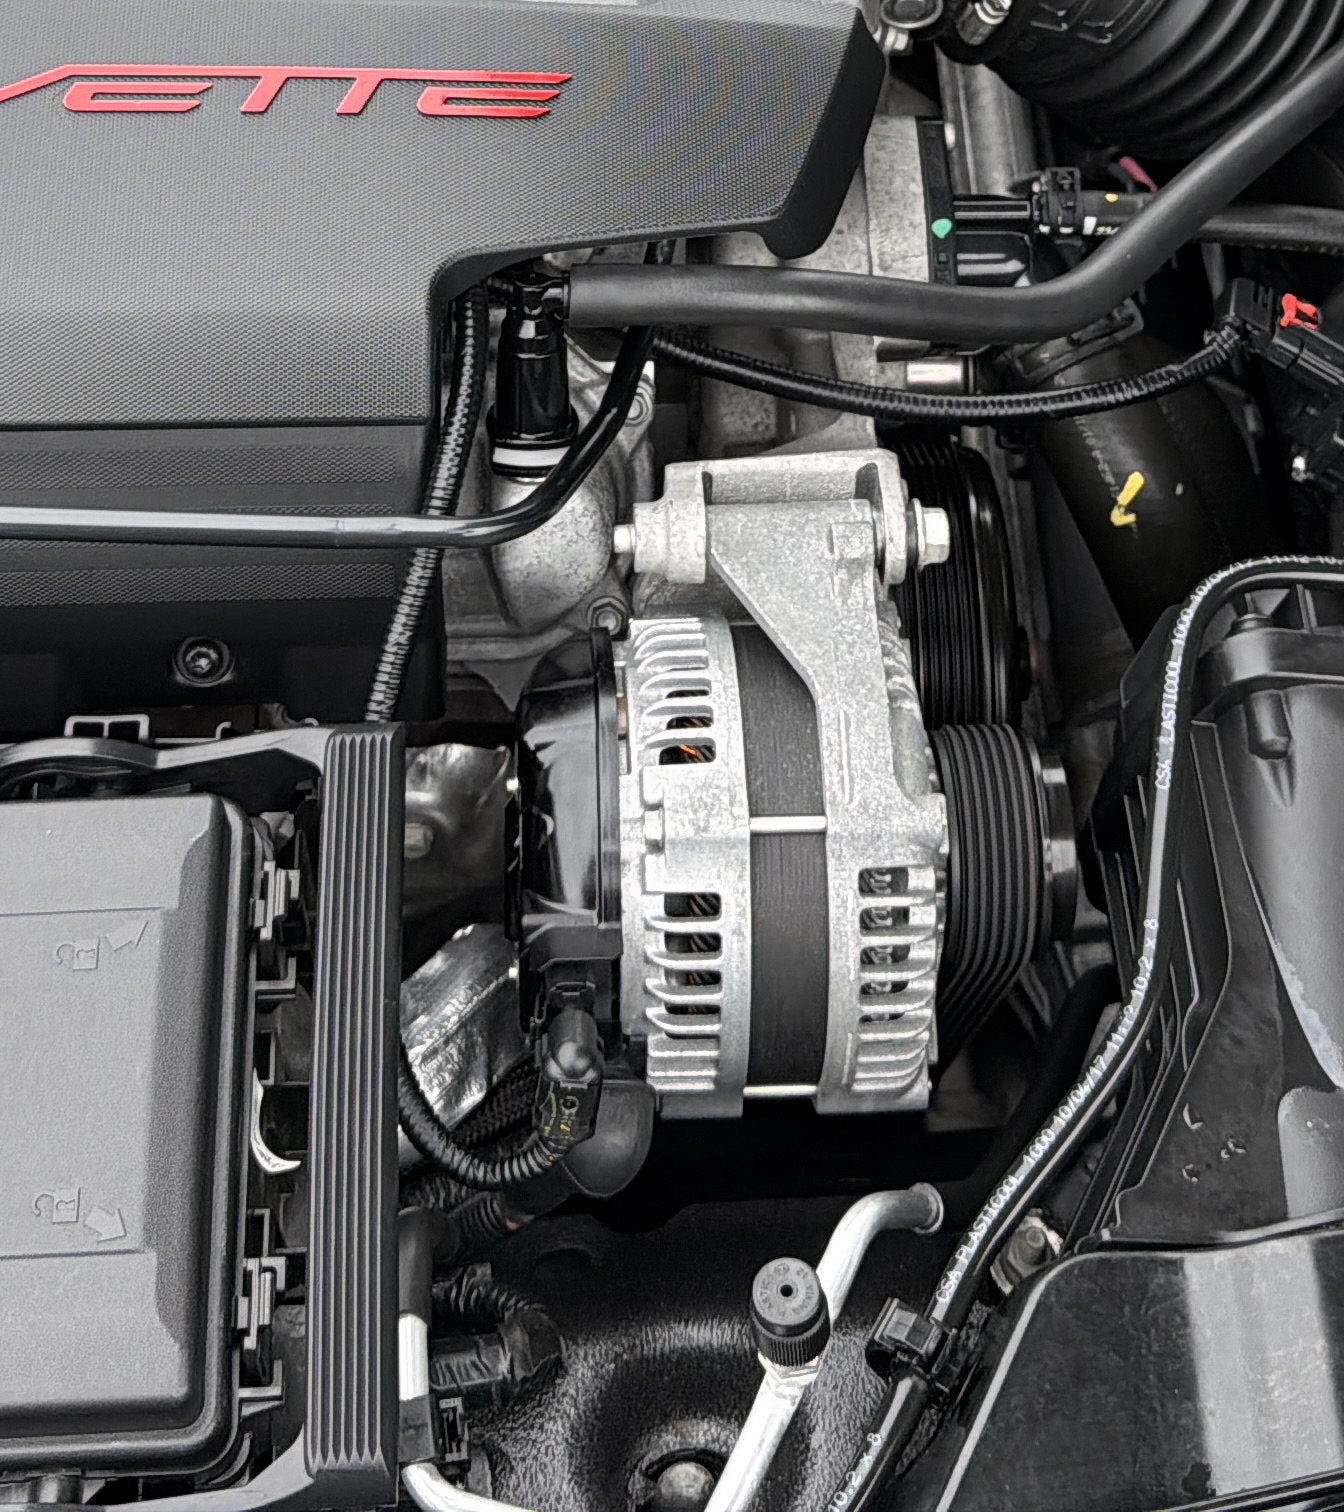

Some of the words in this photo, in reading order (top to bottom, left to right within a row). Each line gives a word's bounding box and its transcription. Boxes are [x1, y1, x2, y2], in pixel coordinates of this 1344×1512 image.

[1156, 654, 1182, 752] LASTICOOL
[936, 1270, 962, 1303] CSA
[955, 1173, 1025, 1261] PLASTICOOL
[1022, 1128, 1056, 1167] 1000
[1052, 1054, 1108, 1126] 10/04/17
[1144, 918, 1159, 931] 8
[867, 1432, 882, 1447] 8
